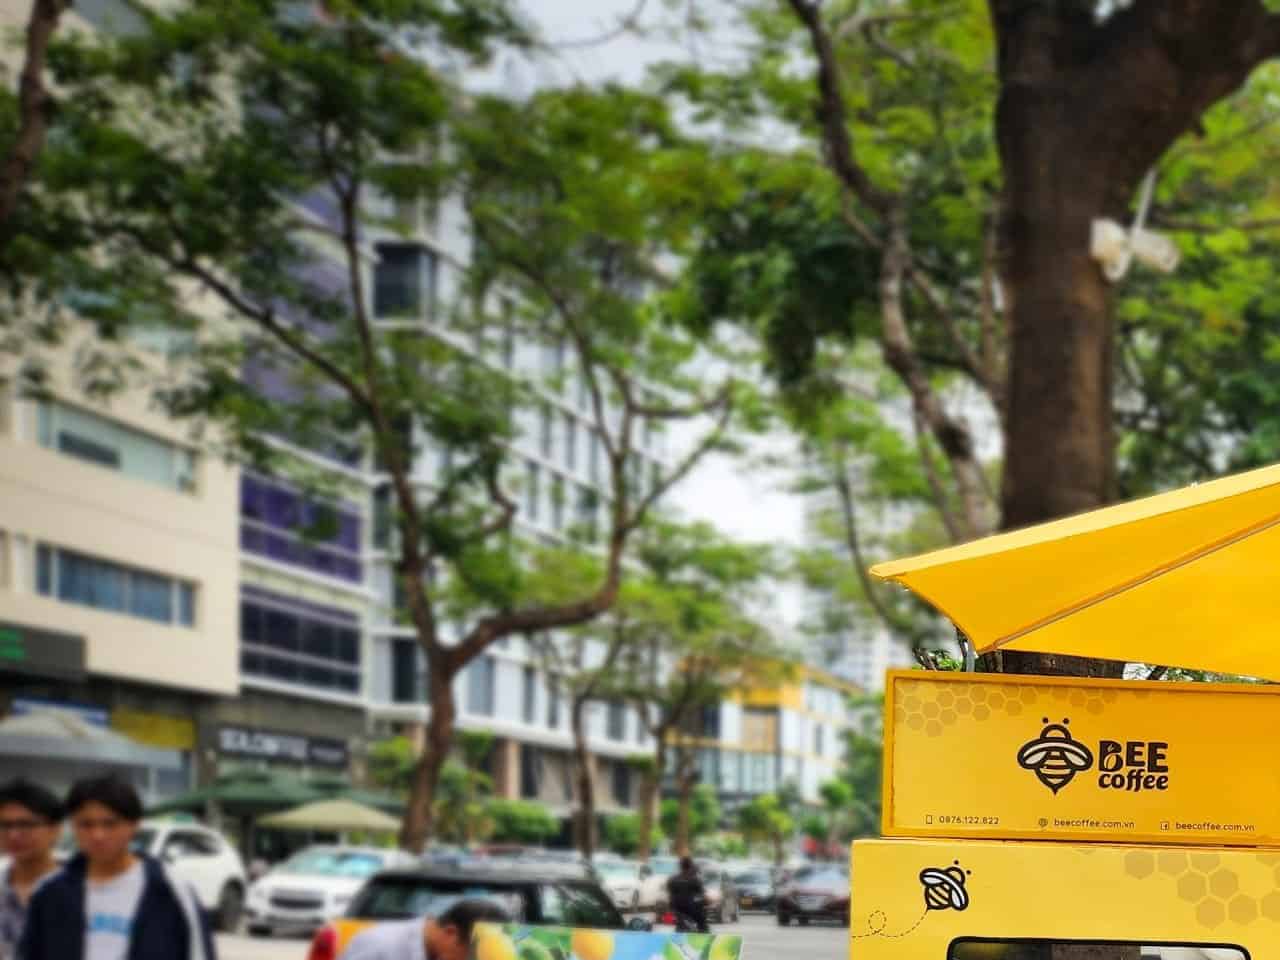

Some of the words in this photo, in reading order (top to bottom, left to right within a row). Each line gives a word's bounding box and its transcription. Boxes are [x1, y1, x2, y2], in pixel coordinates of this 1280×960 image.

[1098, 740, 1169, 772] BEE
[1098, 769, 1169, 792] coffee
[1054, 818, 1135, 829] beecoffee.com.vn
[1175, 822, 1255, 832] beecoffee.com.vn
